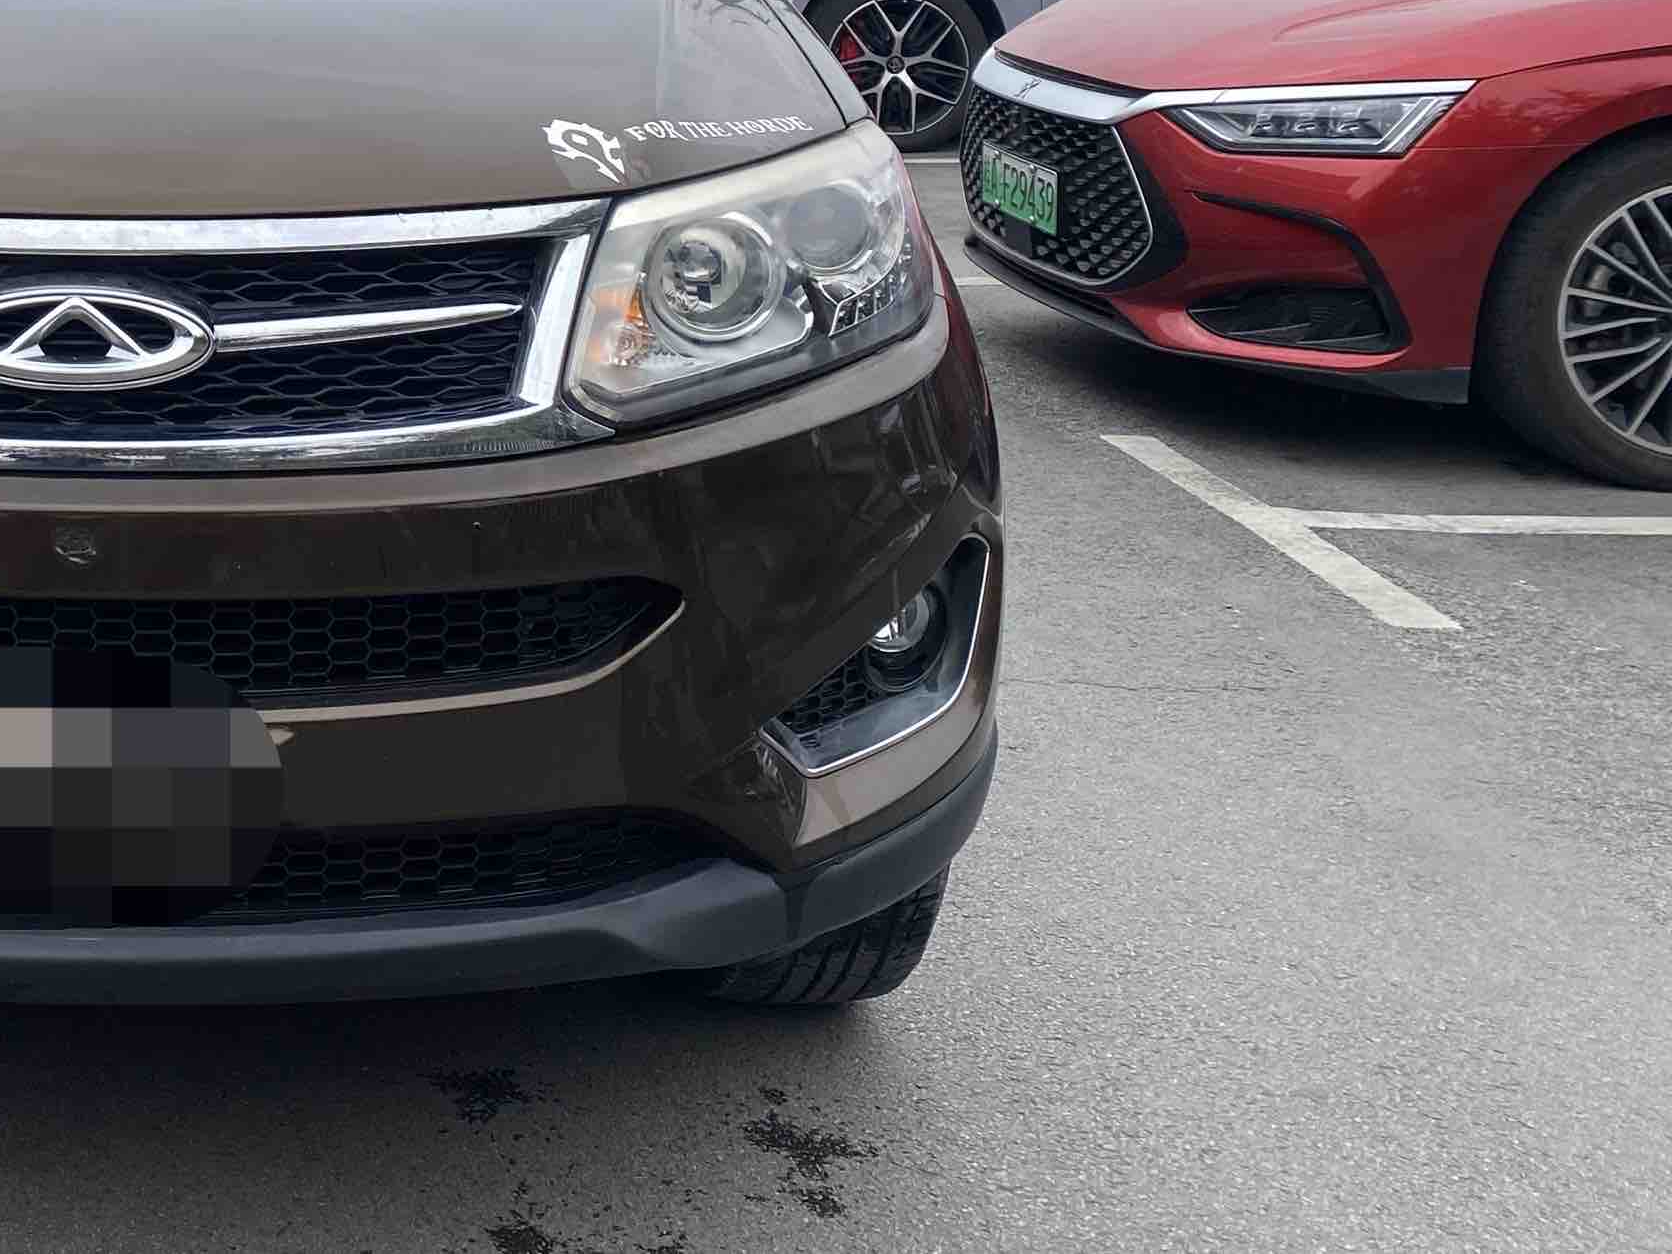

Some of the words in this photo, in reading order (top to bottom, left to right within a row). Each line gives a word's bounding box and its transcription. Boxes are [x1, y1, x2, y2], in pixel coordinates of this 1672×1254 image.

[624, 120, 689, 141] FOR
[678, 121, 732, 139] THE
[726, 115, 815, 135] HORDE
